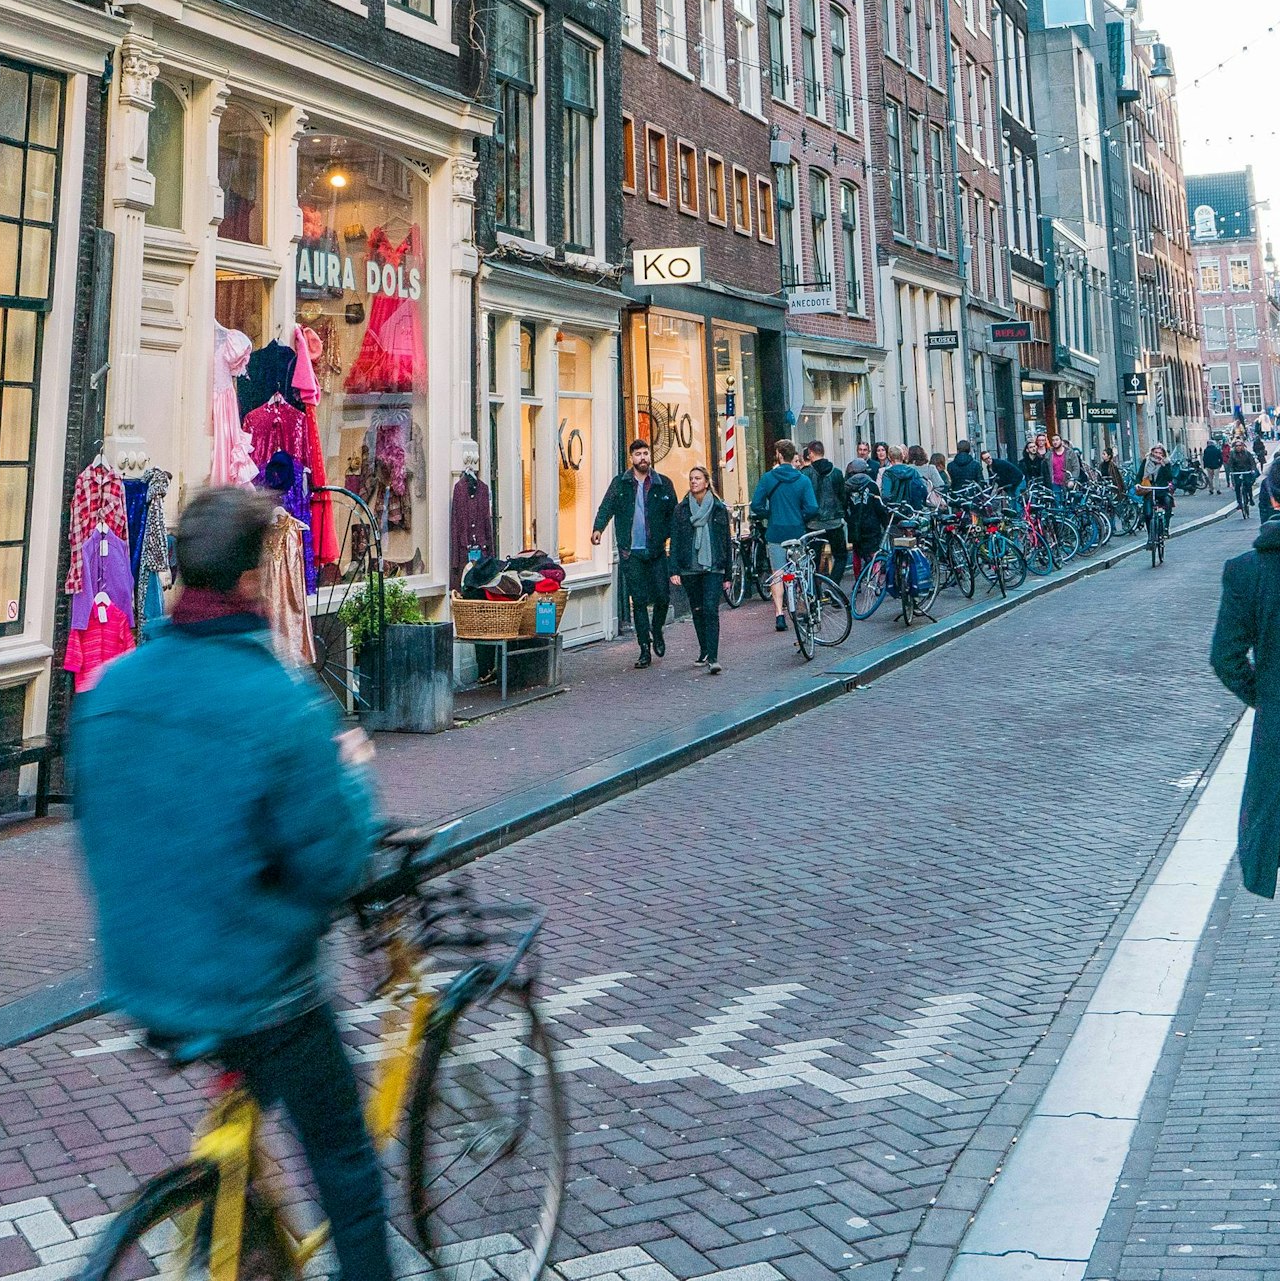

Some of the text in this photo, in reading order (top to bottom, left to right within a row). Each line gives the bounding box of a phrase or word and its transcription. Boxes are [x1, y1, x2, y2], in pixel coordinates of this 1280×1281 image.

[367, 261, 421, 300] DOLS
[791, 297, 831, 308] ANECDOTE
[995, 328, 1027, 337] REPLAY
